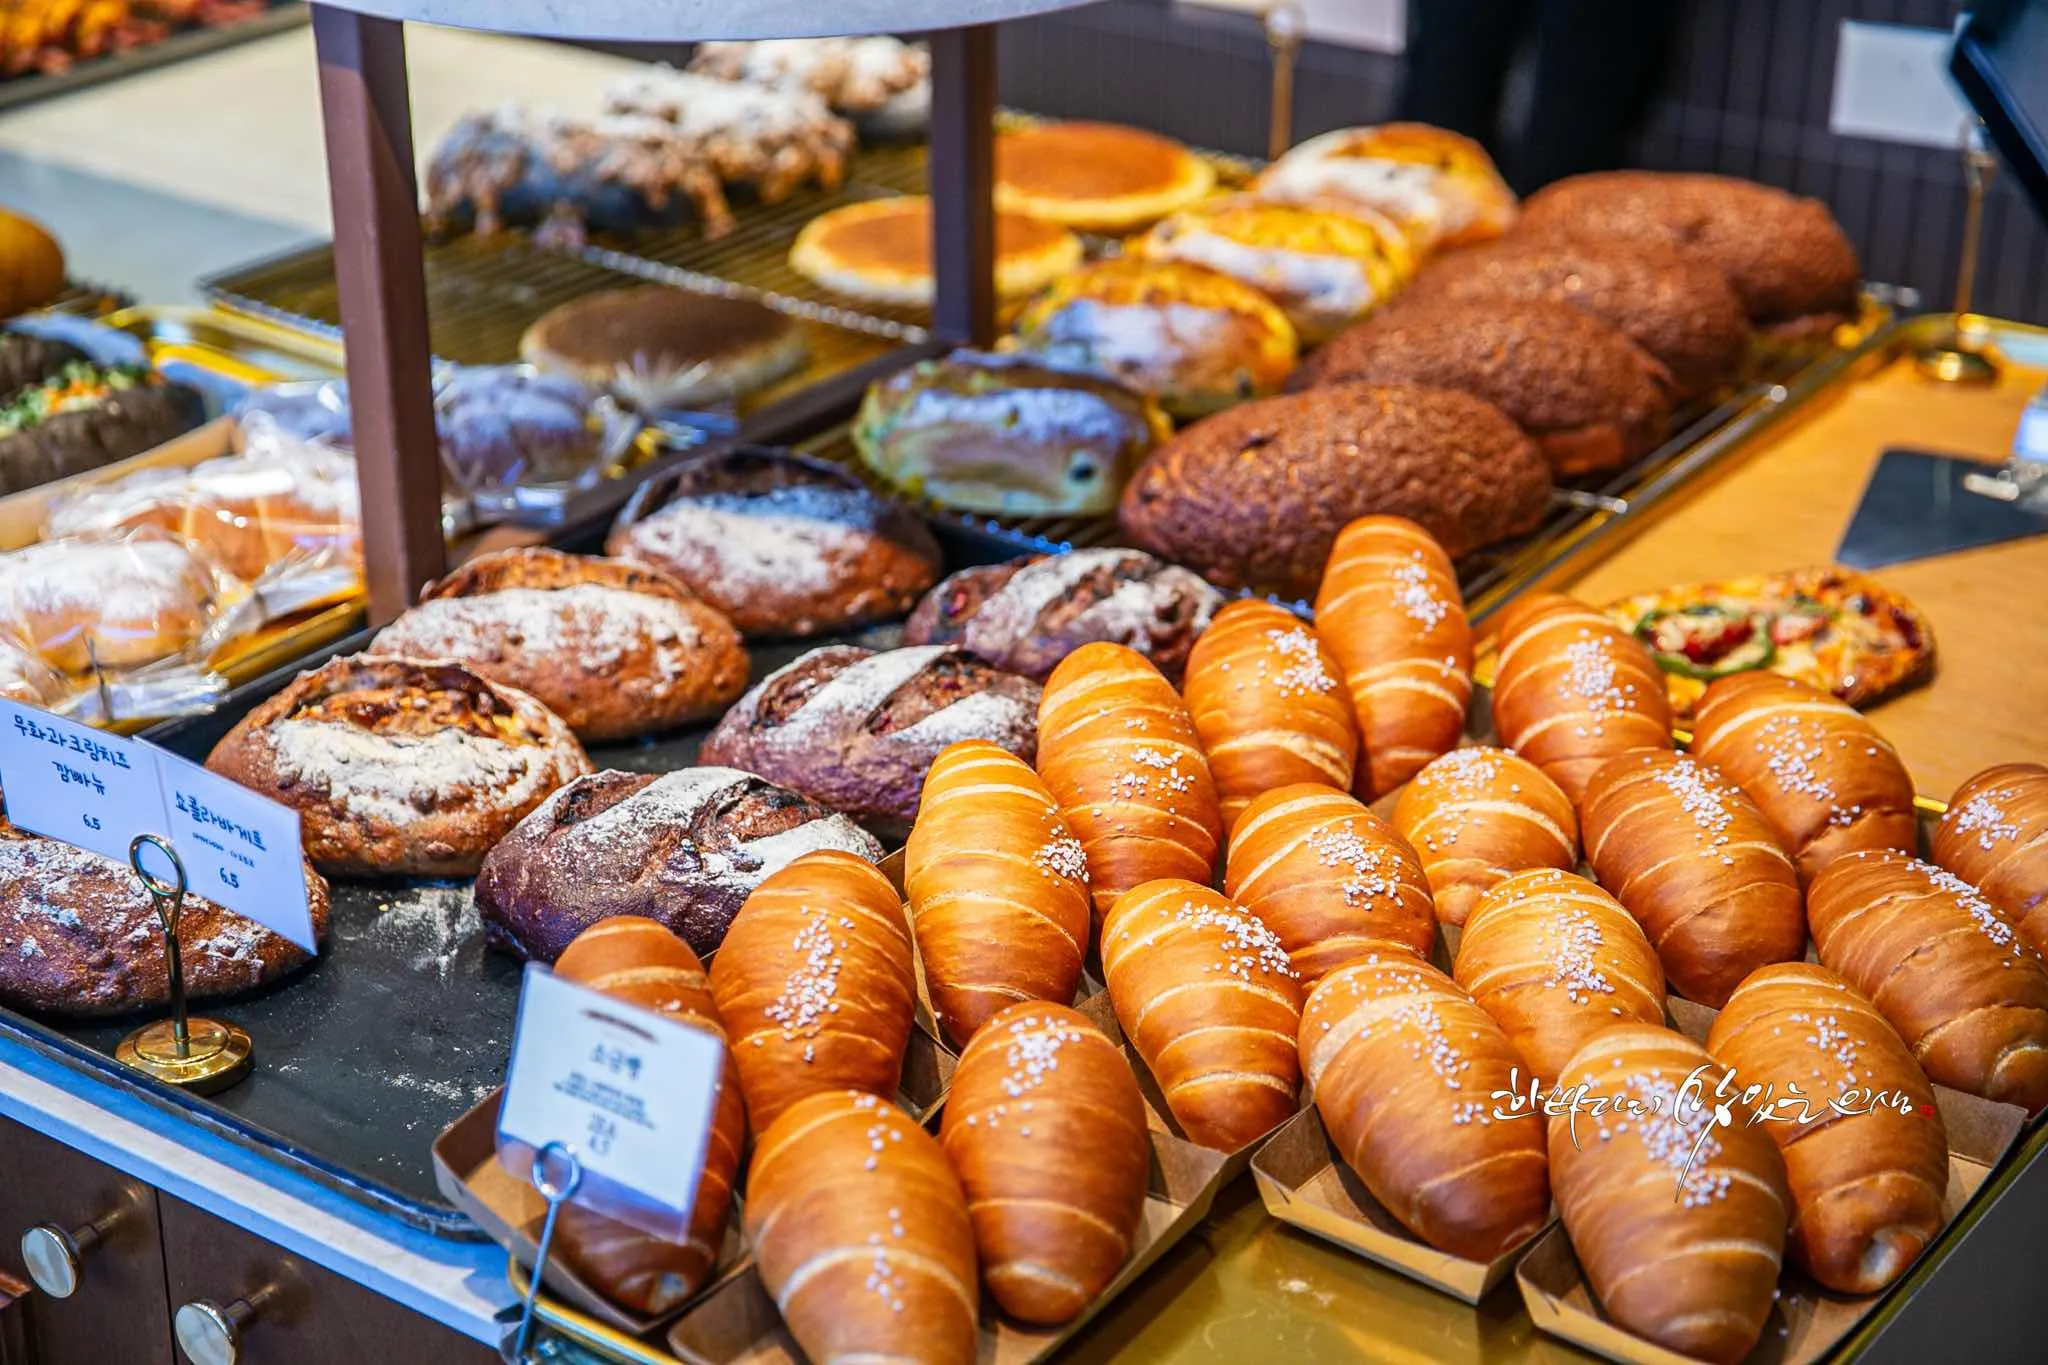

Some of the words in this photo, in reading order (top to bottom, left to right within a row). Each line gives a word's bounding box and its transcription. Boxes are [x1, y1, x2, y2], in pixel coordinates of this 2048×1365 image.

[82, 813, 101, 830] 6.5
[175, 791, 266, 851] 쇼콜라바게트
[219, 867, 239, 888] 6.5
